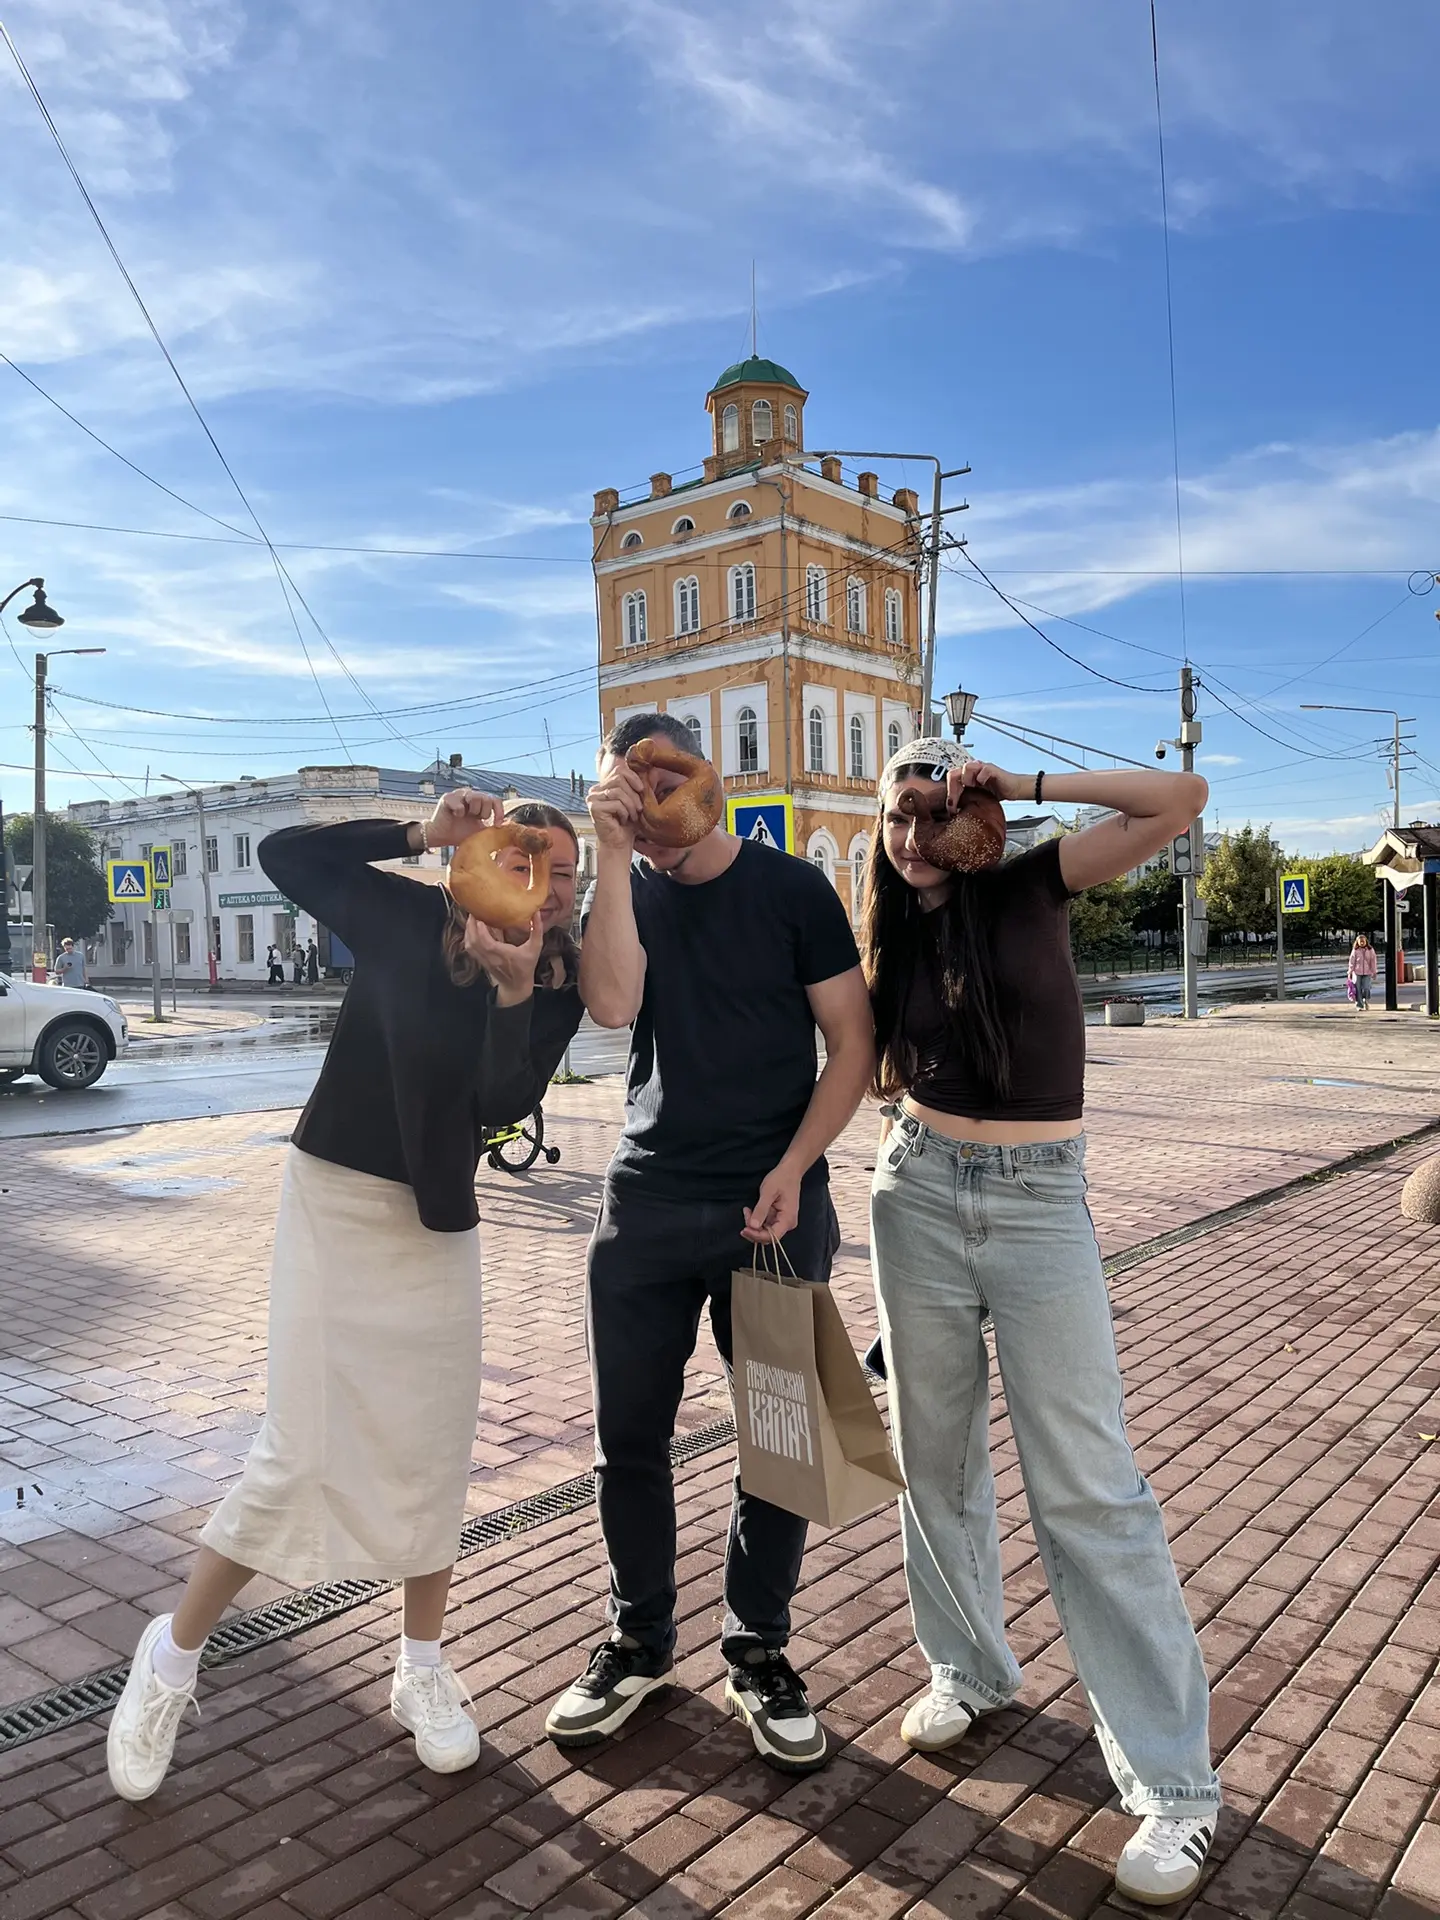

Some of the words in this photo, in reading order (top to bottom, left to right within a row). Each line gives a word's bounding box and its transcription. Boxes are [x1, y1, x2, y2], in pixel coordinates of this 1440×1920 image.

[227, 896, 250, 904] АПТЕКА
[256, 893, 283, 903] ОПТИКА
[746, 1359, 807, 1405] МУРОМСКИЙ
[747, 1389, 814, 1467] КАЛАЧ
